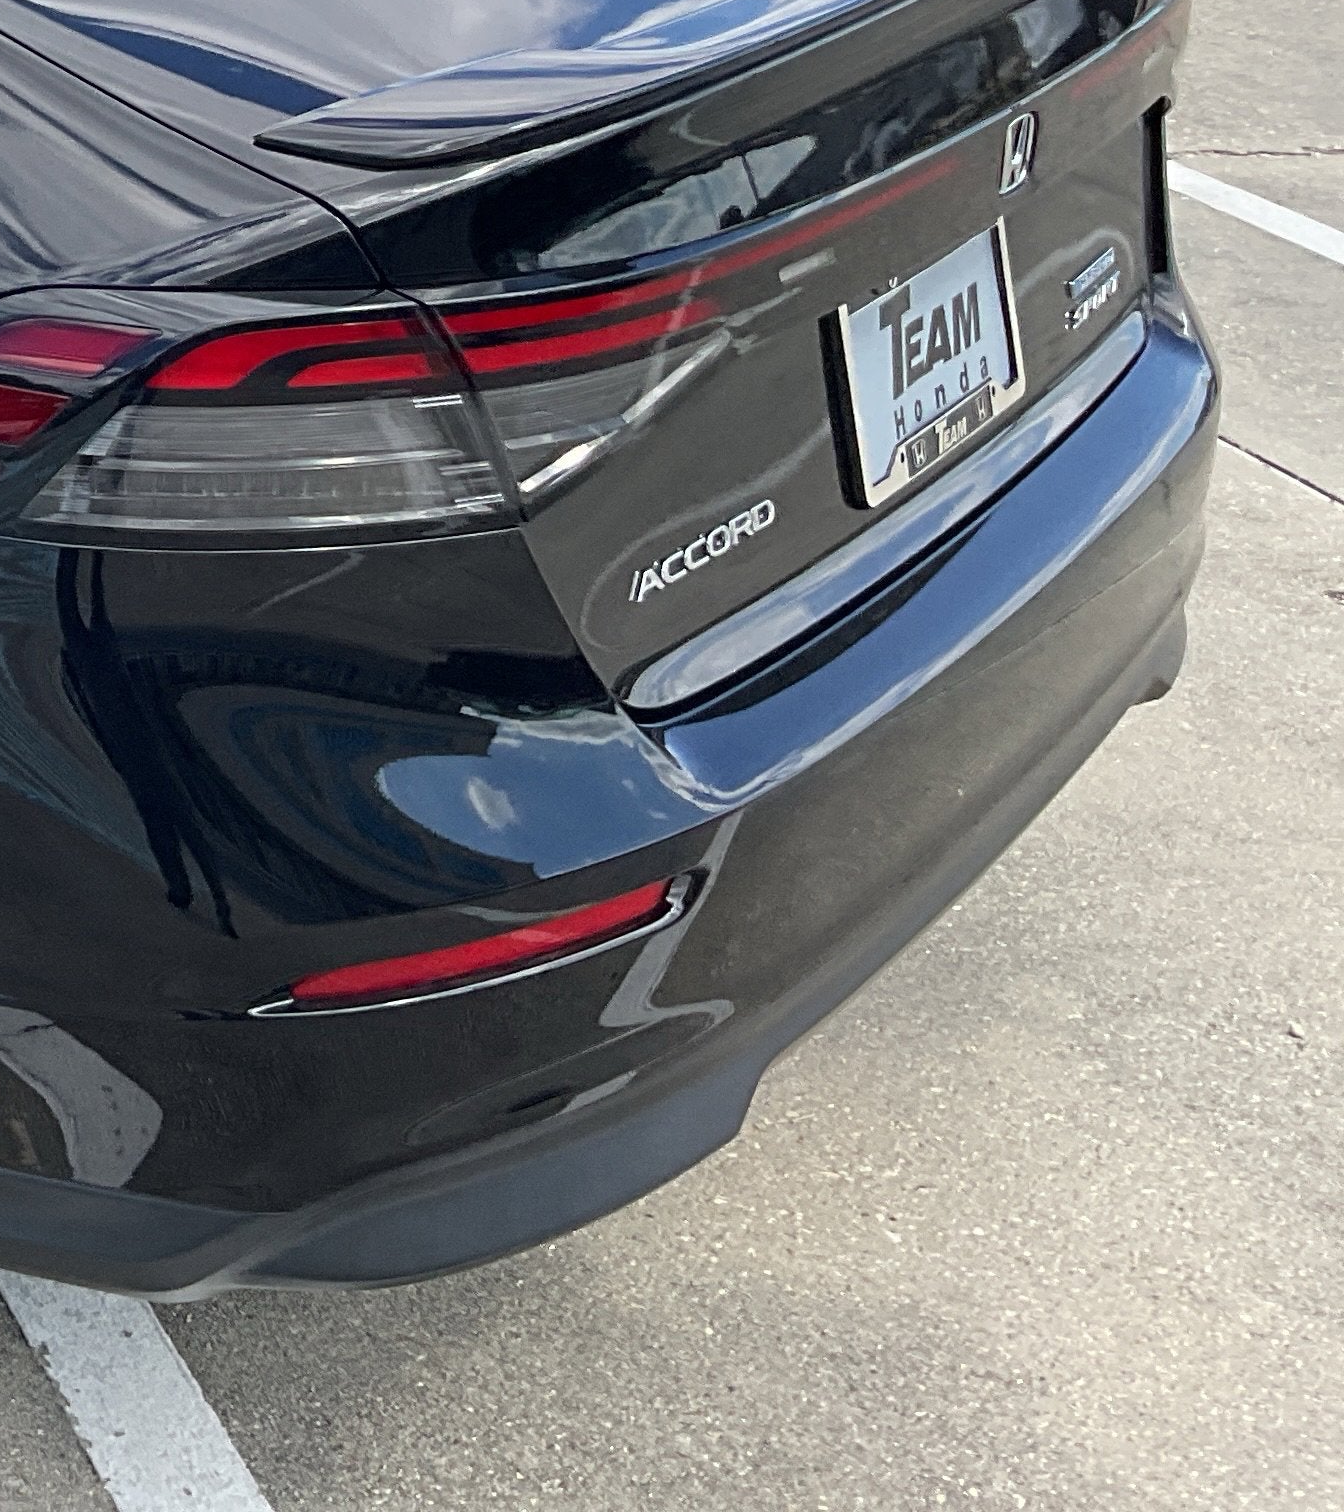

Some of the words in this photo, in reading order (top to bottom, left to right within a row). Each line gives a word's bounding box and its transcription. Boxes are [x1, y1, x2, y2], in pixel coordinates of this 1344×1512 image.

[879, 282, 981, 400] TEAM
[893, 355, 990, 440] Honda
[934, 416, 967, 455] TEAM
[629, 499, 775, 603] ACCORD
